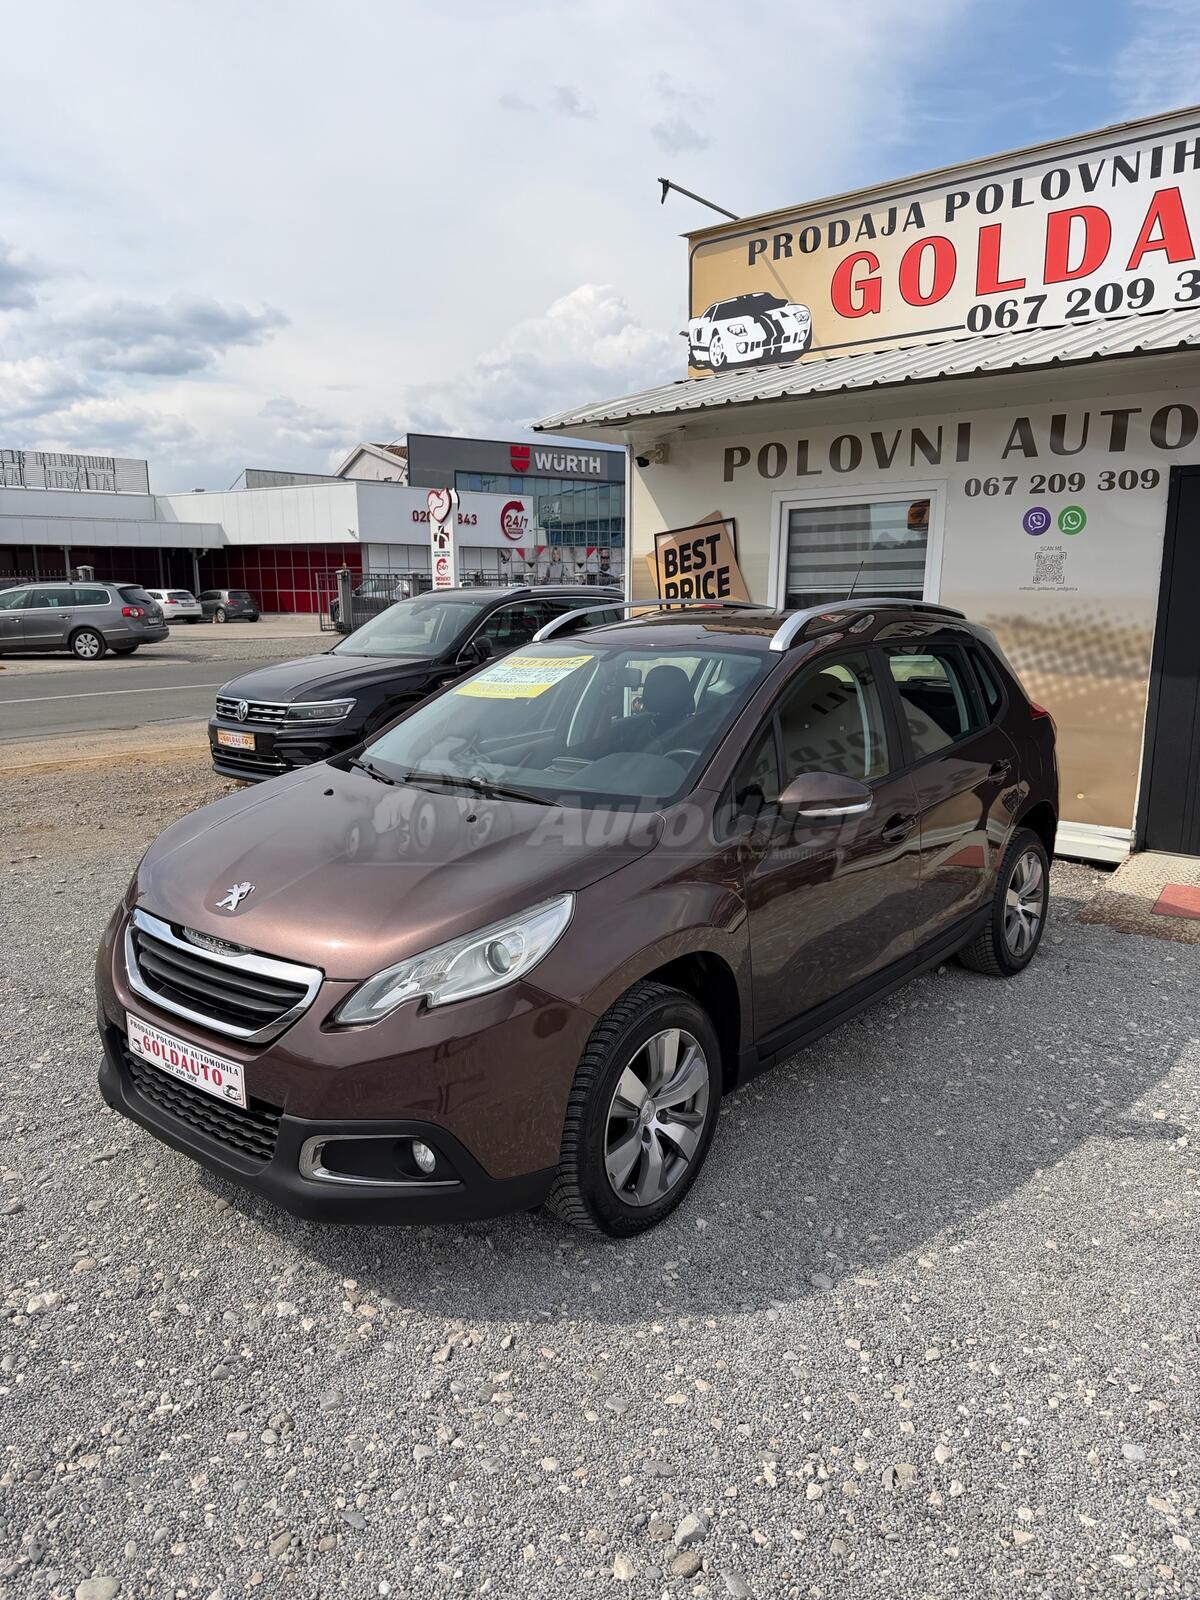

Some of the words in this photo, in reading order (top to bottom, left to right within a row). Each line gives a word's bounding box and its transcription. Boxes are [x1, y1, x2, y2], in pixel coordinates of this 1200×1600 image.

[748, 201, 926, 266] PRODAJA
[945, 137, 1200, 223] POLOVNIH
[830, 186, 1196, 319] GOLDA
[966, 294, 1047, 333] 067
[1065, 278, 1155, 319] 209
[723, 422, 971, 482] POLOVNI
[1001, 404, 1199, 460] AUTO
[964, 476, 1018, 497] 067
[1029, 472, 1086, 494] 209
[1098, 468, 1160, 491] 309
[505, 514, 528, 528] 24/7
[664, 532, 721, 579] BEST
[664, 565, 731, 609] PRICE
[130, 1019, 155, 1039] PRODAJA
[156, 1033, 188, 1055] POLOVNIH
[190, 1050, 239, 1077] AUTOMOBILA
[143, 1035, 223, 1087] GOLDAUTO
